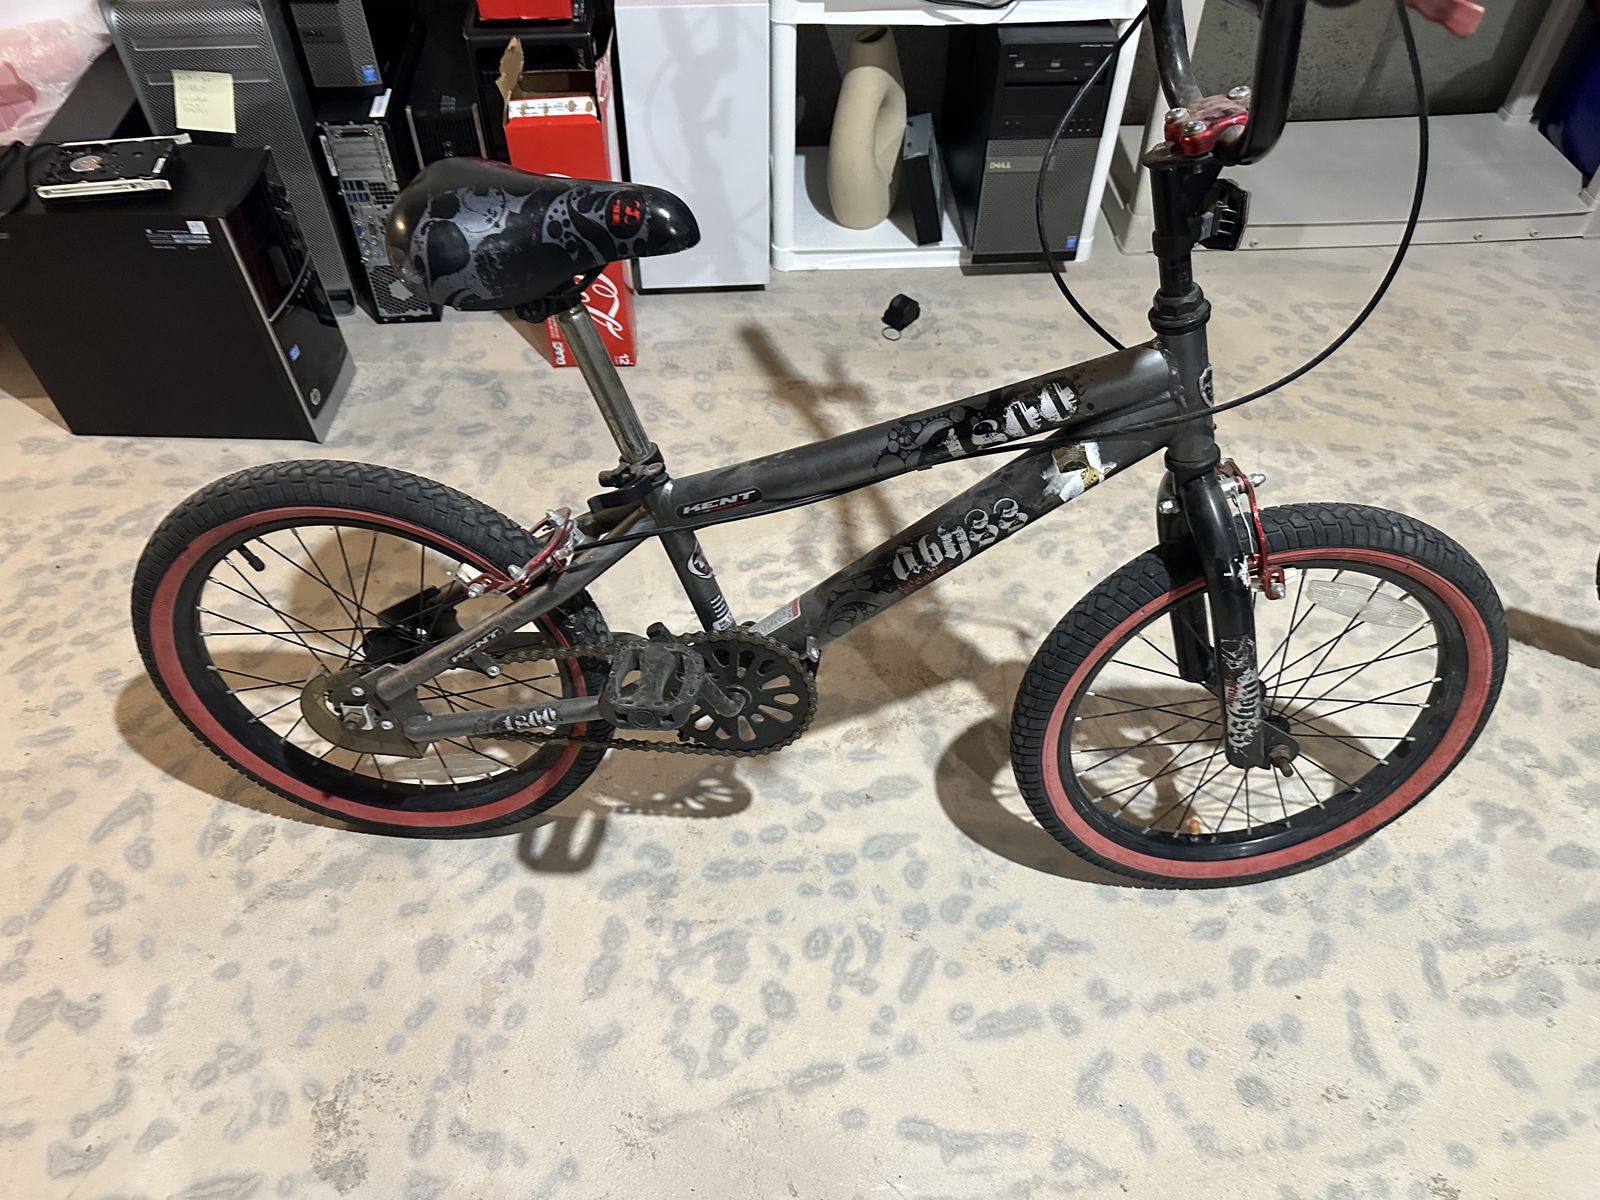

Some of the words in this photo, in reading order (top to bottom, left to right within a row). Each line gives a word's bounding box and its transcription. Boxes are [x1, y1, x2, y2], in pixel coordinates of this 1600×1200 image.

[989, 161, 1011, 169] DELL
[682, 490, 756, 514] KENT
[451, 629, 499, 662] KENT
